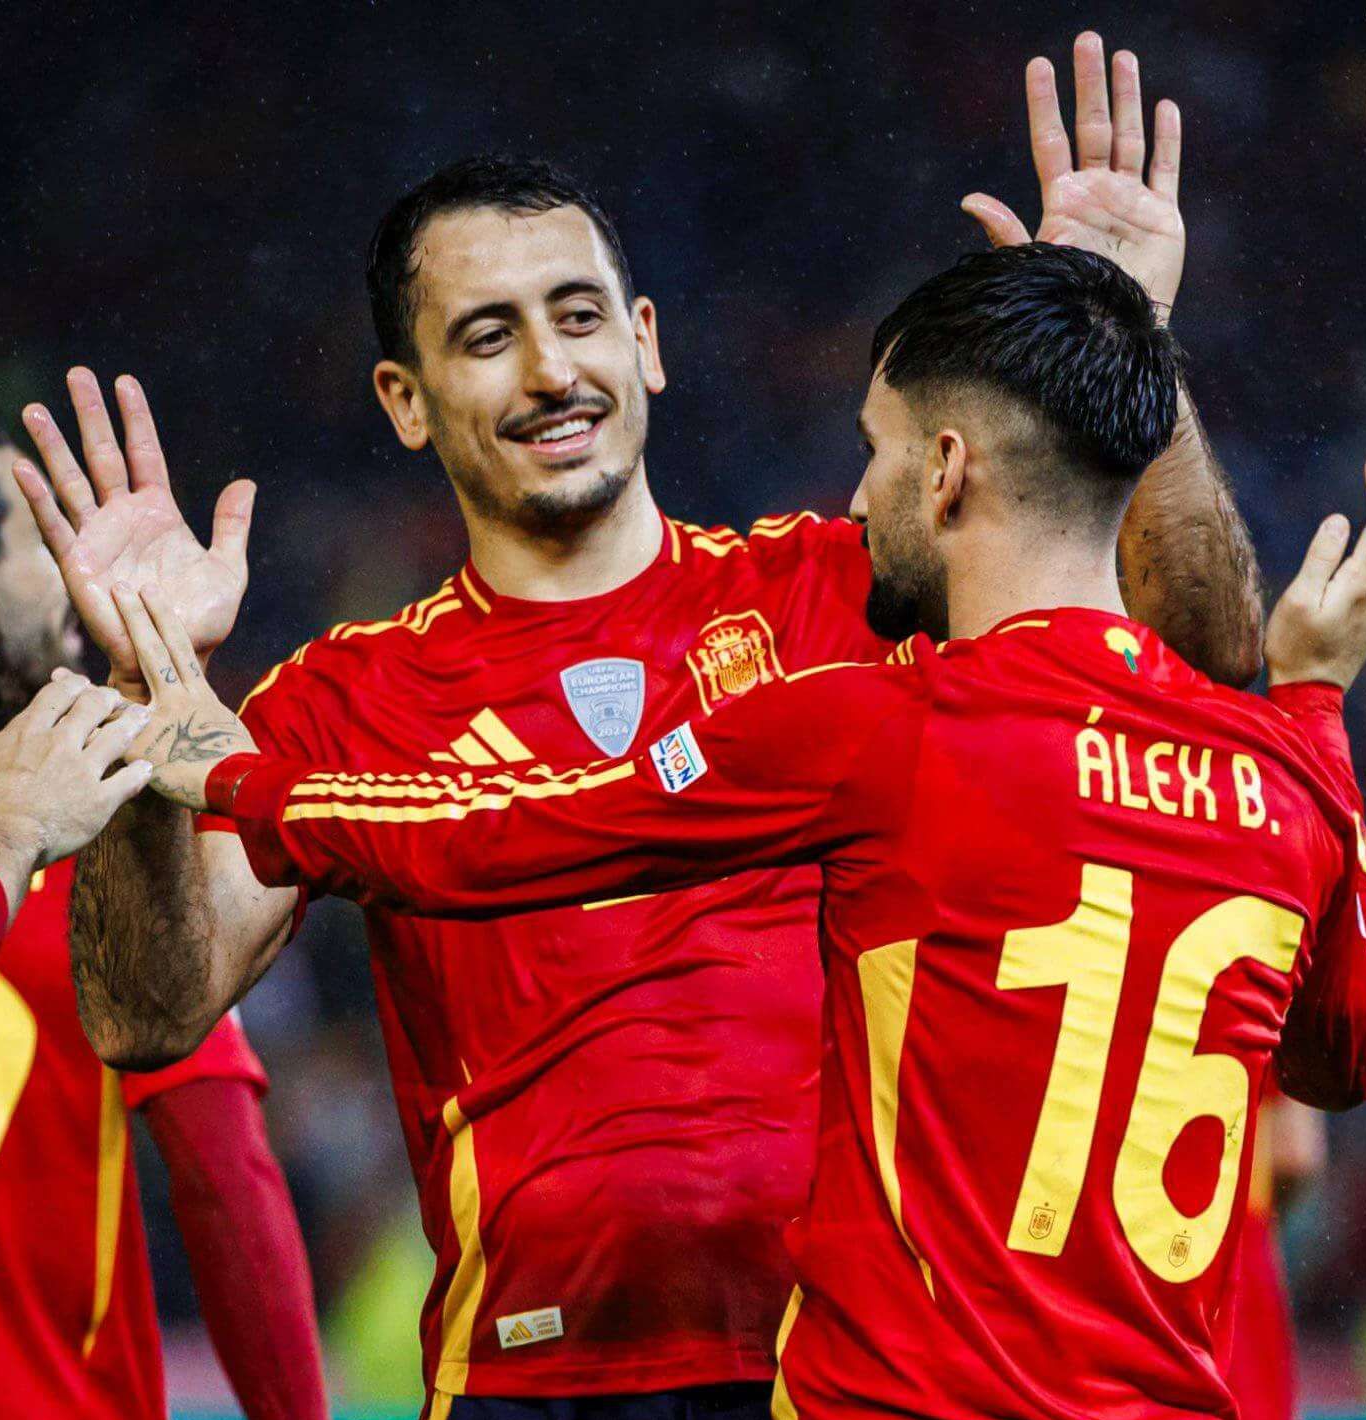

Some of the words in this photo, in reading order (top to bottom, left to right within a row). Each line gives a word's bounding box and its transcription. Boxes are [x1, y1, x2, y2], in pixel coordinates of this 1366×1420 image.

[1076, 706, 1217, 821] ÁLEX
[1232, 753, 1281, 834] B.
[995, 863, 1305, 1283] 16
